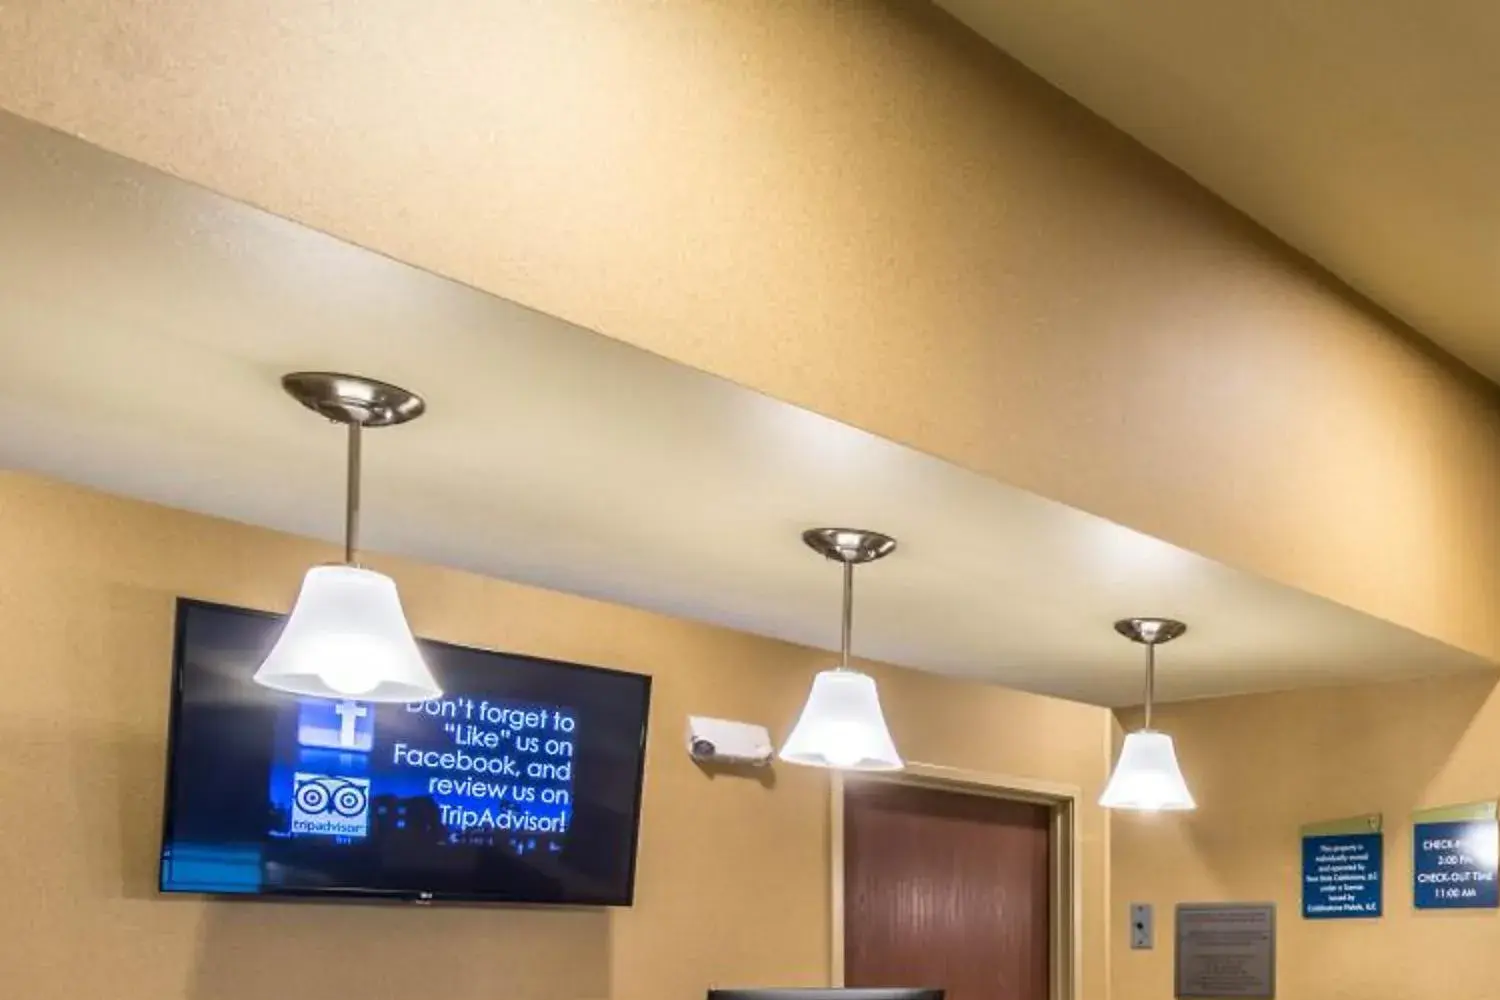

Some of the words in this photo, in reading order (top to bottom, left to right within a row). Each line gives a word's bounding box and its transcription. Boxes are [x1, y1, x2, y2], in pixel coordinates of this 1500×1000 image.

[406, 698, 474, 719] Don't
[480, 701, 548, 730] forget
[554, 711, 575, 732] to
[445, 723, 511, 748] "Like"
[516, 735, 539, 752] us
[545, 739, 573, 756] on
[393, 743, 521, 777] Facebook,
[527, 761, 571, 781] and
[429, 777, 507, 799] review
[512, 785, 535, 801] us
[541, 788, 569, 805] on
[439, 804, 566, 833] TripAdvisor!
[1417, 872, 1470, 883] CHECK-OUT
[1462, 888, 1477, 897] AM
